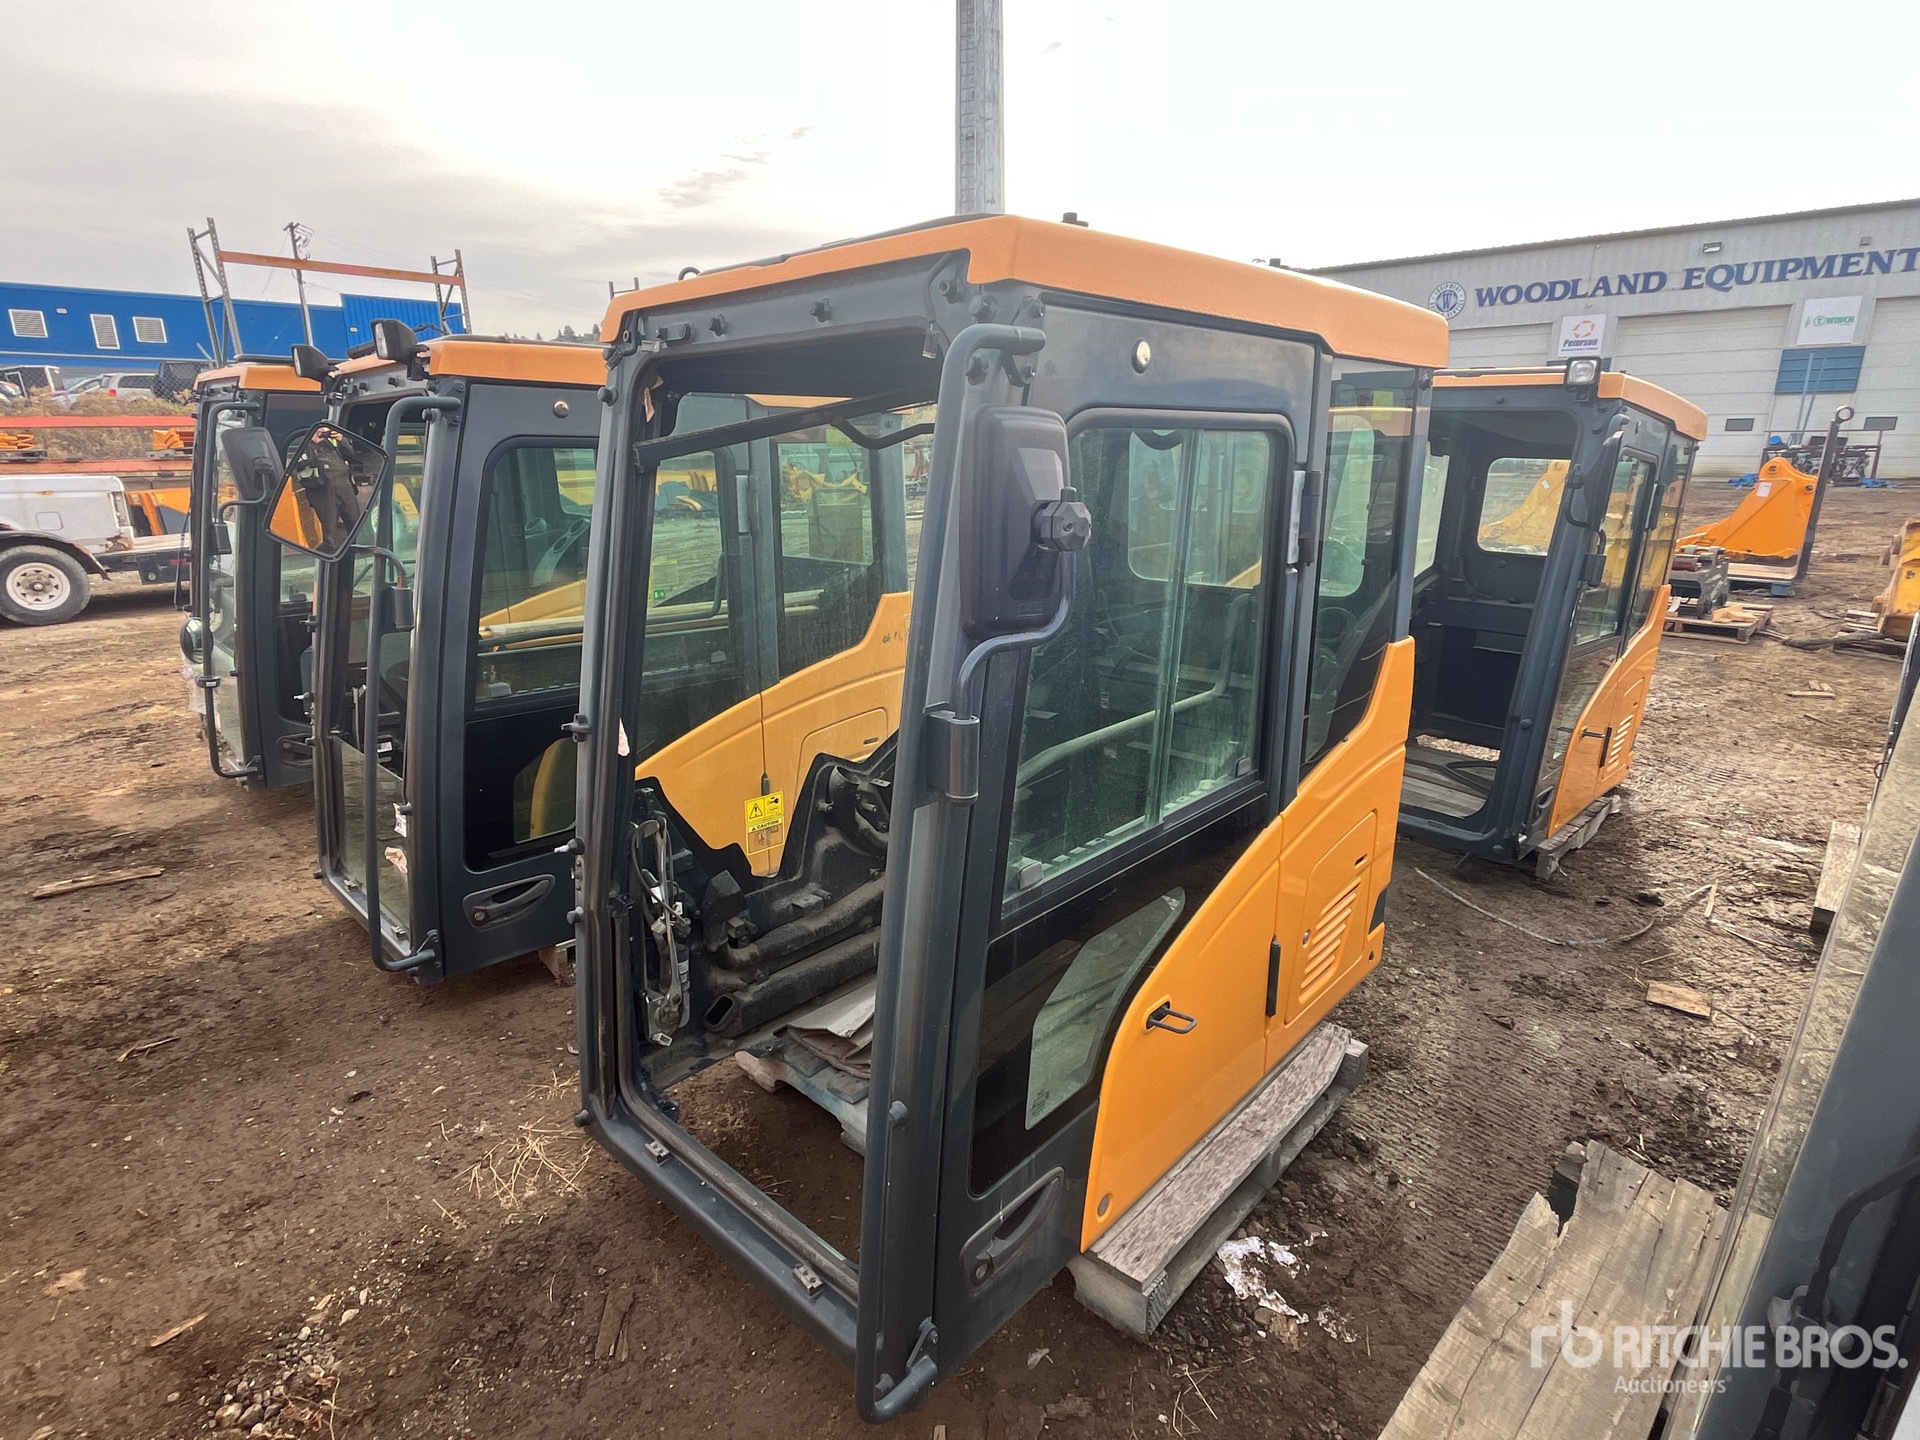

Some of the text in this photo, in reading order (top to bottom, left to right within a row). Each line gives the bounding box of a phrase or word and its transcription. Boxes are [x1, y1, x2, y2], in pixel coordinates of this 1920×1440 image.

[1474, 247, 1920, 308] WOODLAND EQUIPMENT
[1562, 338, 1598, 348] Peterson
[757, 819, 779, 830] CAUTION
